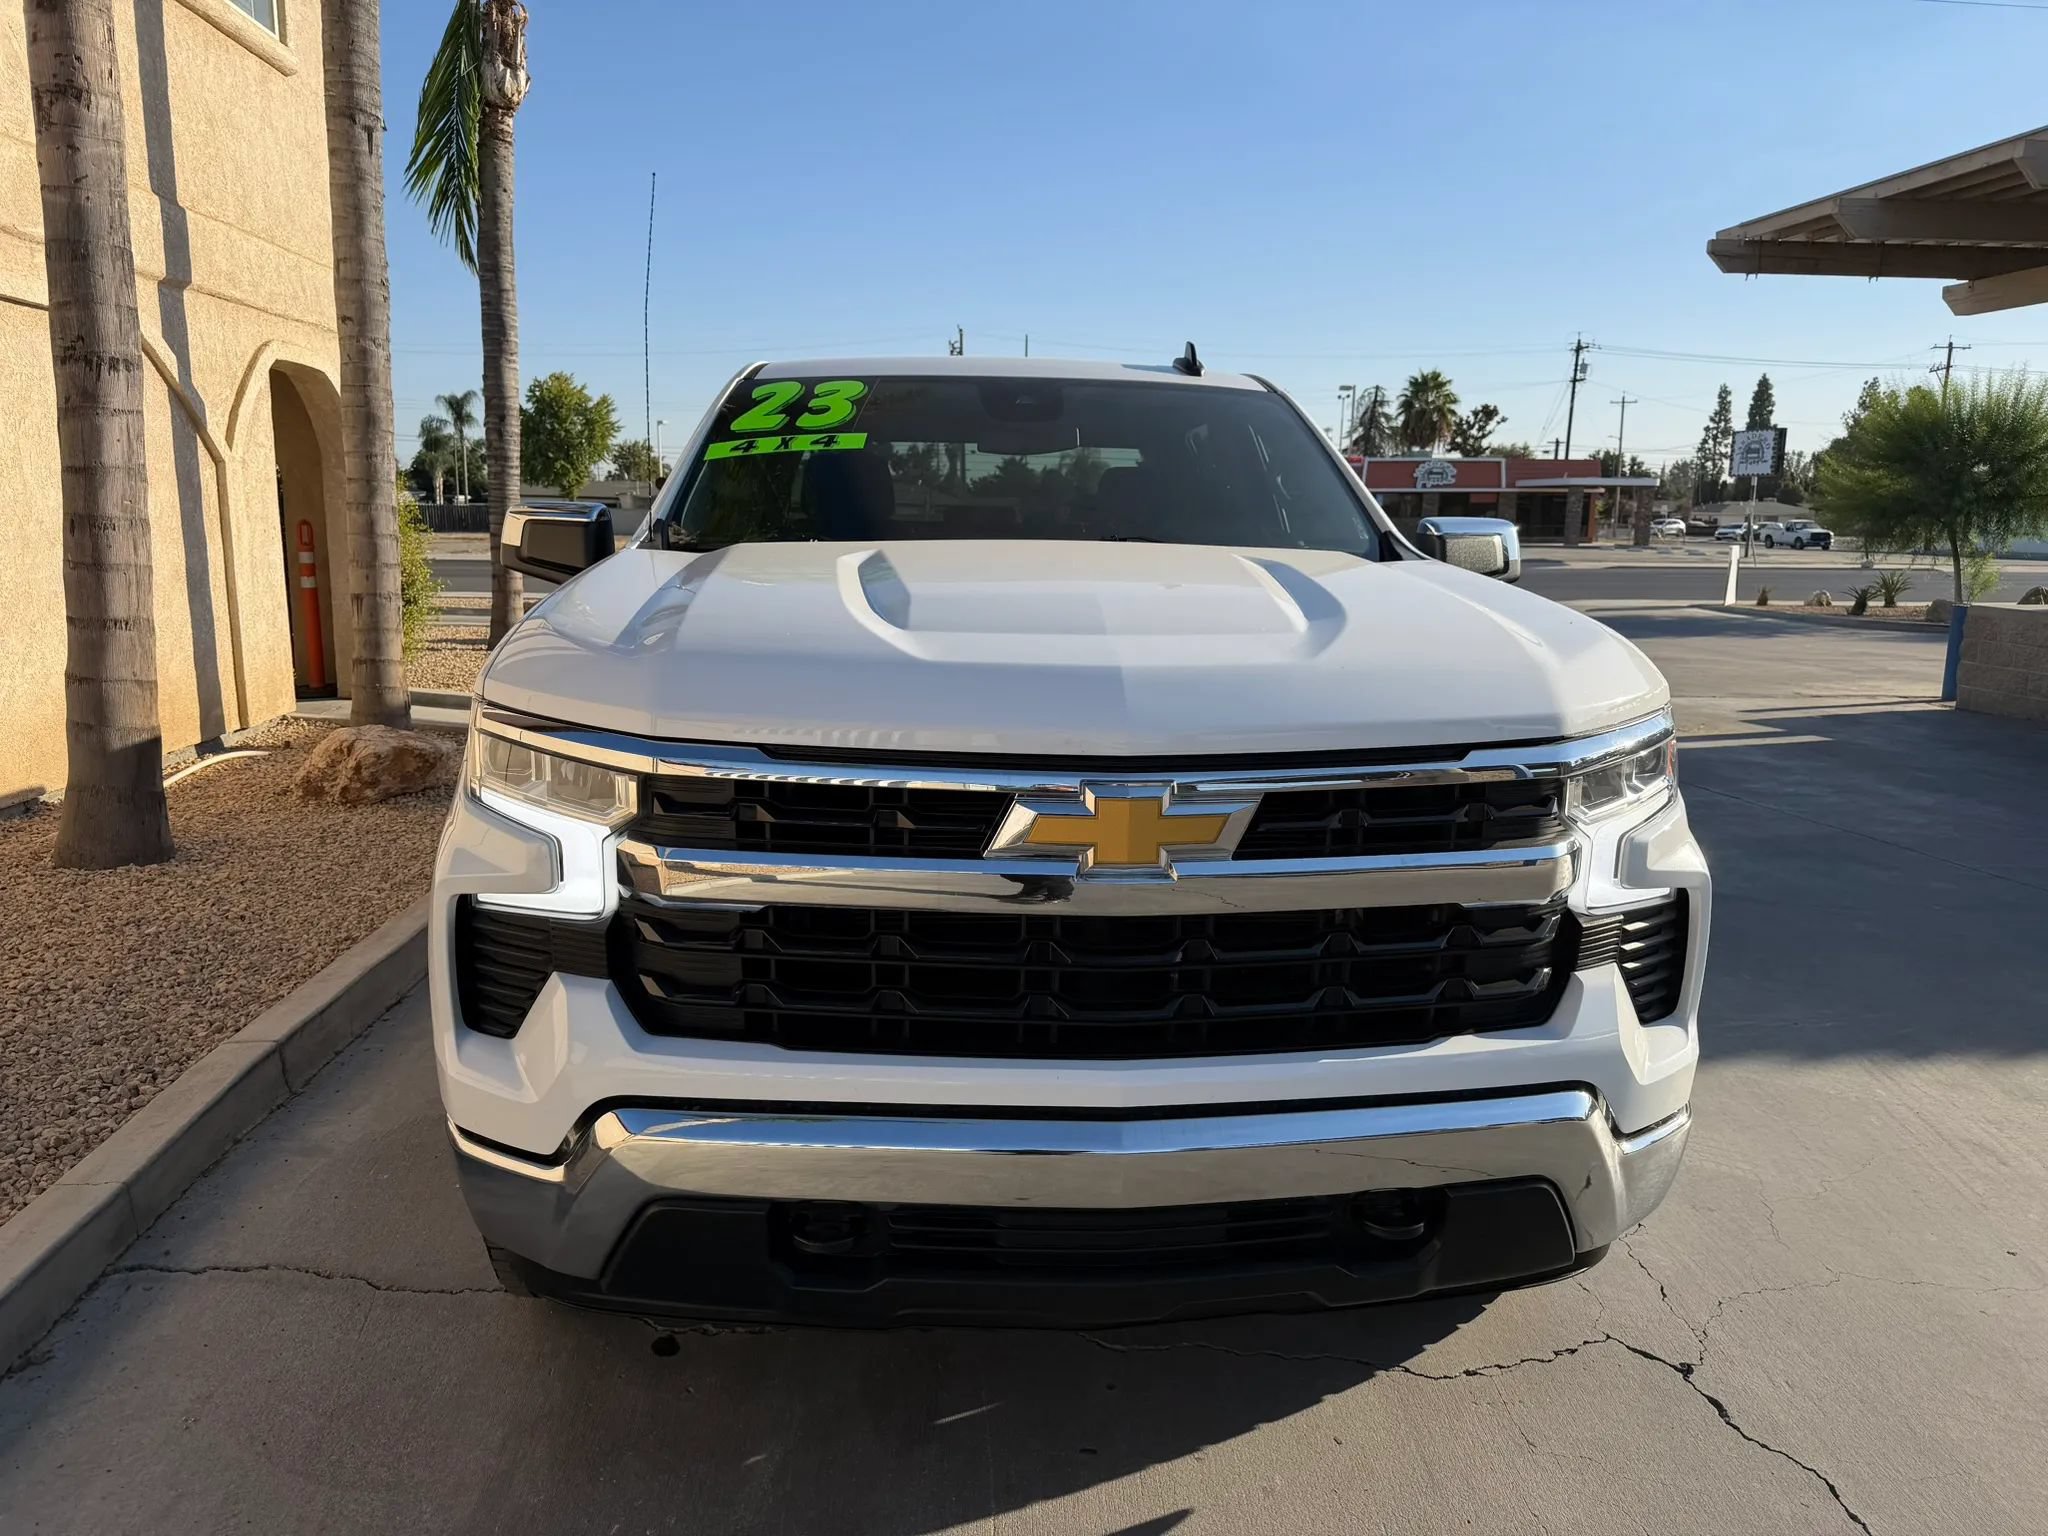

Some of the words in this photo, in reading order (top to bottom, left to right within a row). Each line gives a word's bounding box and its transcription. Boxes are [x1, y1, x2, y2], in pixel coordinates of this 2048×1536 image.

[730, 381, 868, 432] 23
[729, 440, 759, 453] 4
[809, 435, 840, 448] 4
